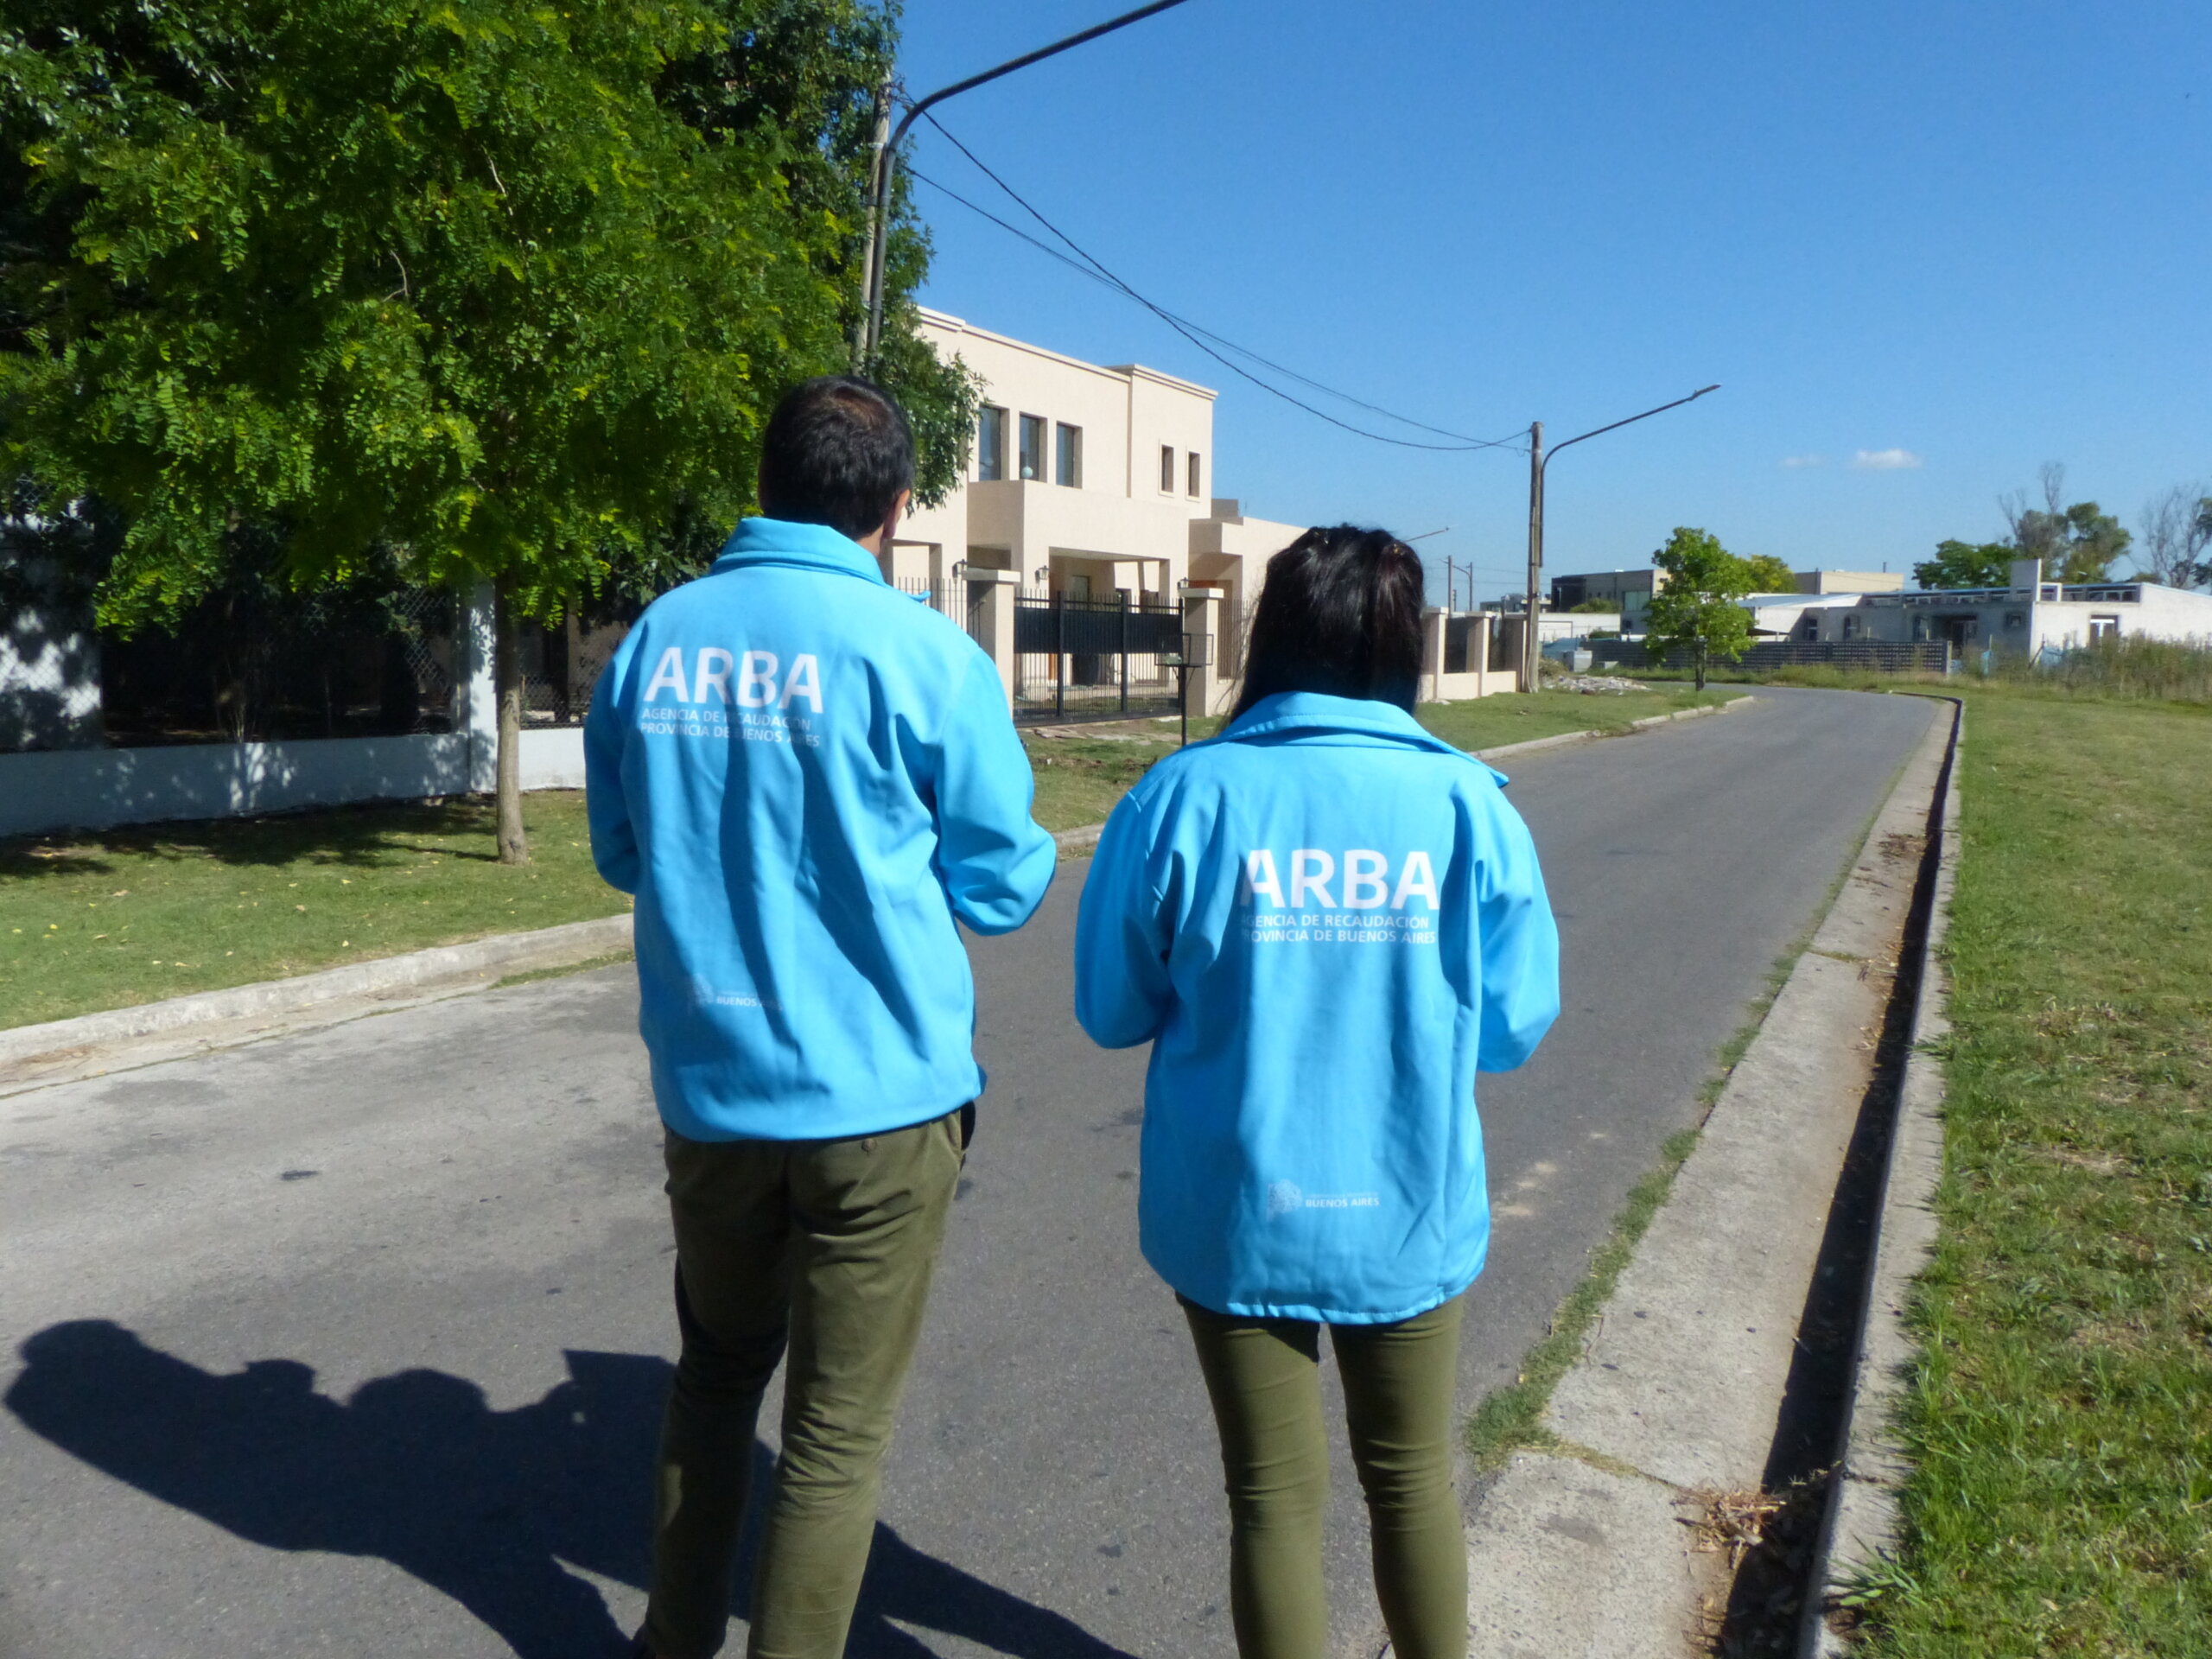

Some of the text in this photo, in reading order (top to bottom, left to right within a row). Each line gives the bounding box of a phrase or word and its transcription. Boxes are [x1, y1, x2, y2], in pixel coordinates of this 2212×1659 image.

[643, 646, 823, 713] ARBA
[641, 708, 699, 721] AGENCIA
[703, 710, 720, 722] DE
[713, 726, 729, 738] DE
[1240, 849, 1440, 910] ARBA
[1301, 914, 1319, 927] DE
[1313, 930, 1332, 942] DE
[1338, 930, 1396, 942] BUENOS
[1401, 931, 1436, 944] AIRES
[1306, 1197, 1380, 1208] BUENOS AIRES
